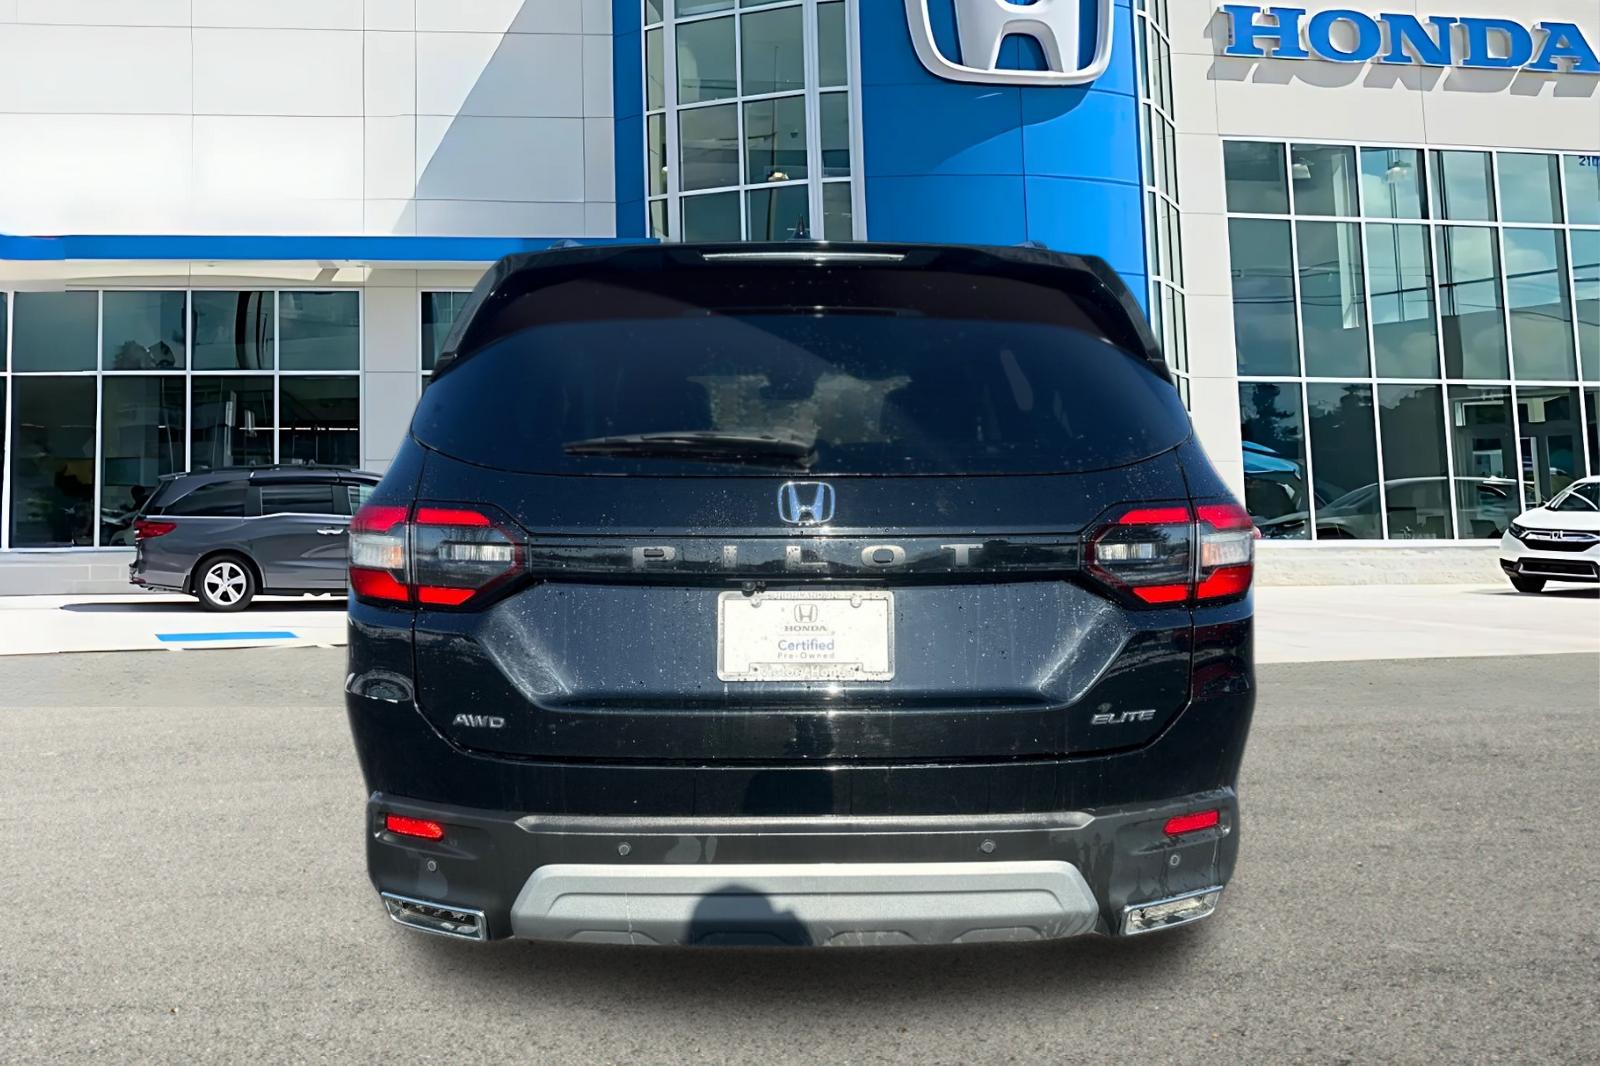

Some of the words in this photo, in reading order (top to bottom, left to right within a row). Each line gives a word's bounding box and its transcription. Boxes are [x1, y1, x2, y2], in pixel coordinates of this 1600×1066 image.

[1222, 4, 1600, 73] HONDA
[632, 543, 984, 569] PILOT
[777, 639, 835, 651] Certified
[452, 713, 505, 728] AWD
[1091, 709, 1156, 725] ELITE
